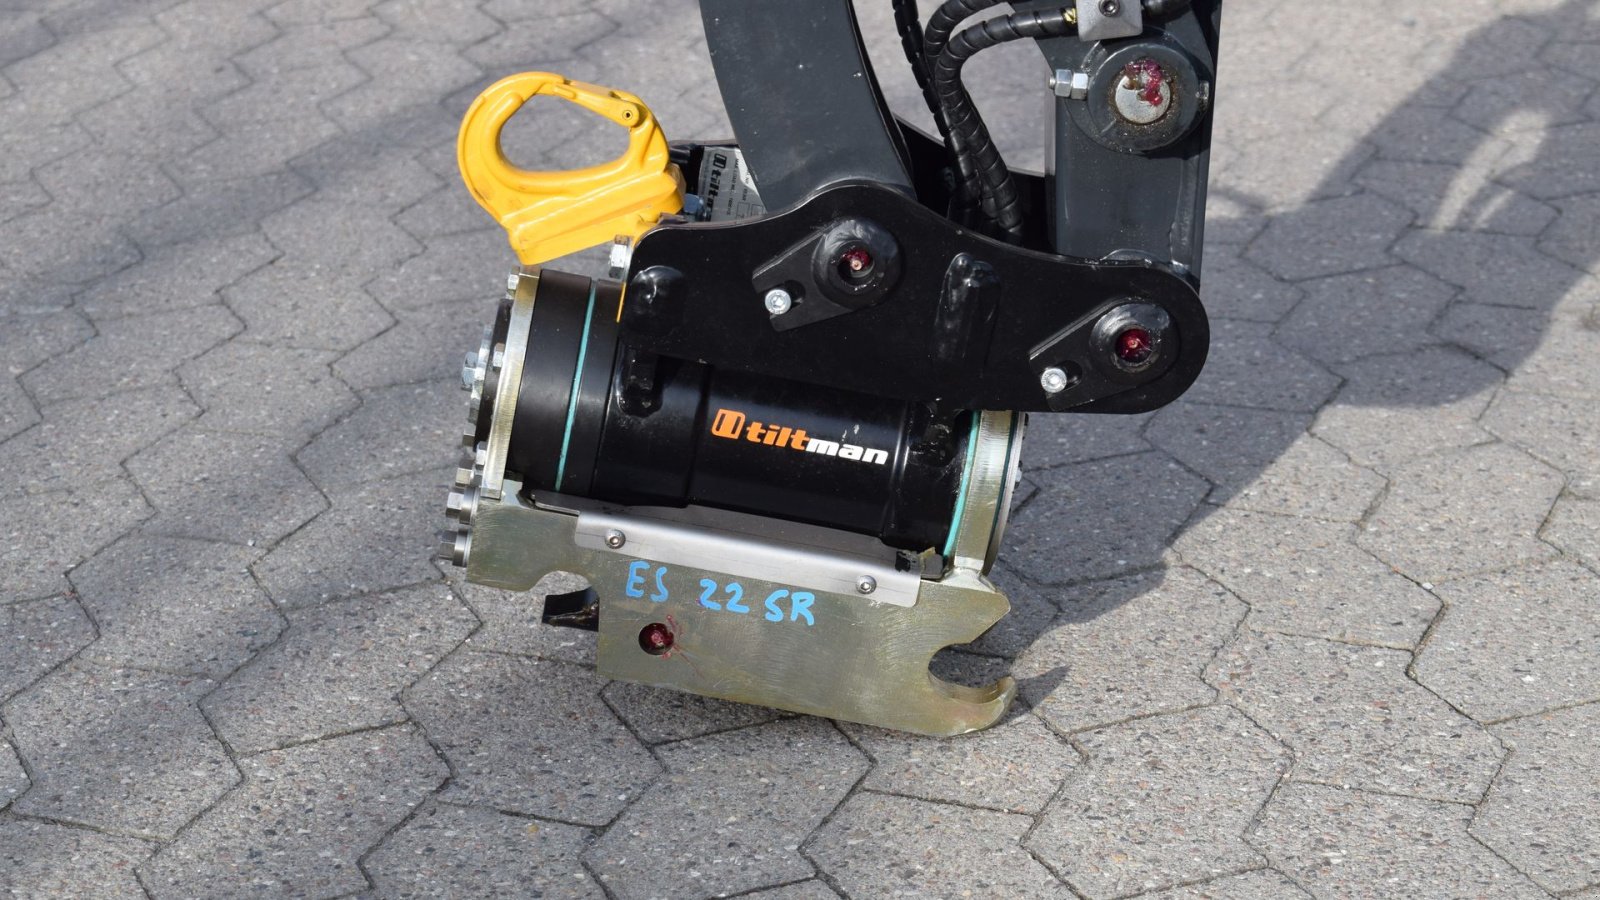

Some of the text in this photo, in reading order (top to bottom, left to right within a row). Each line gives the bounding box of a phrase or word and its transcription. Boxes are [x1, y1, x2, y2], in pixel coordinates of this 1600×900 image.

[746, 421, 889, 465] tiltman
[625, 560, 816, 626] ES 22 SR
